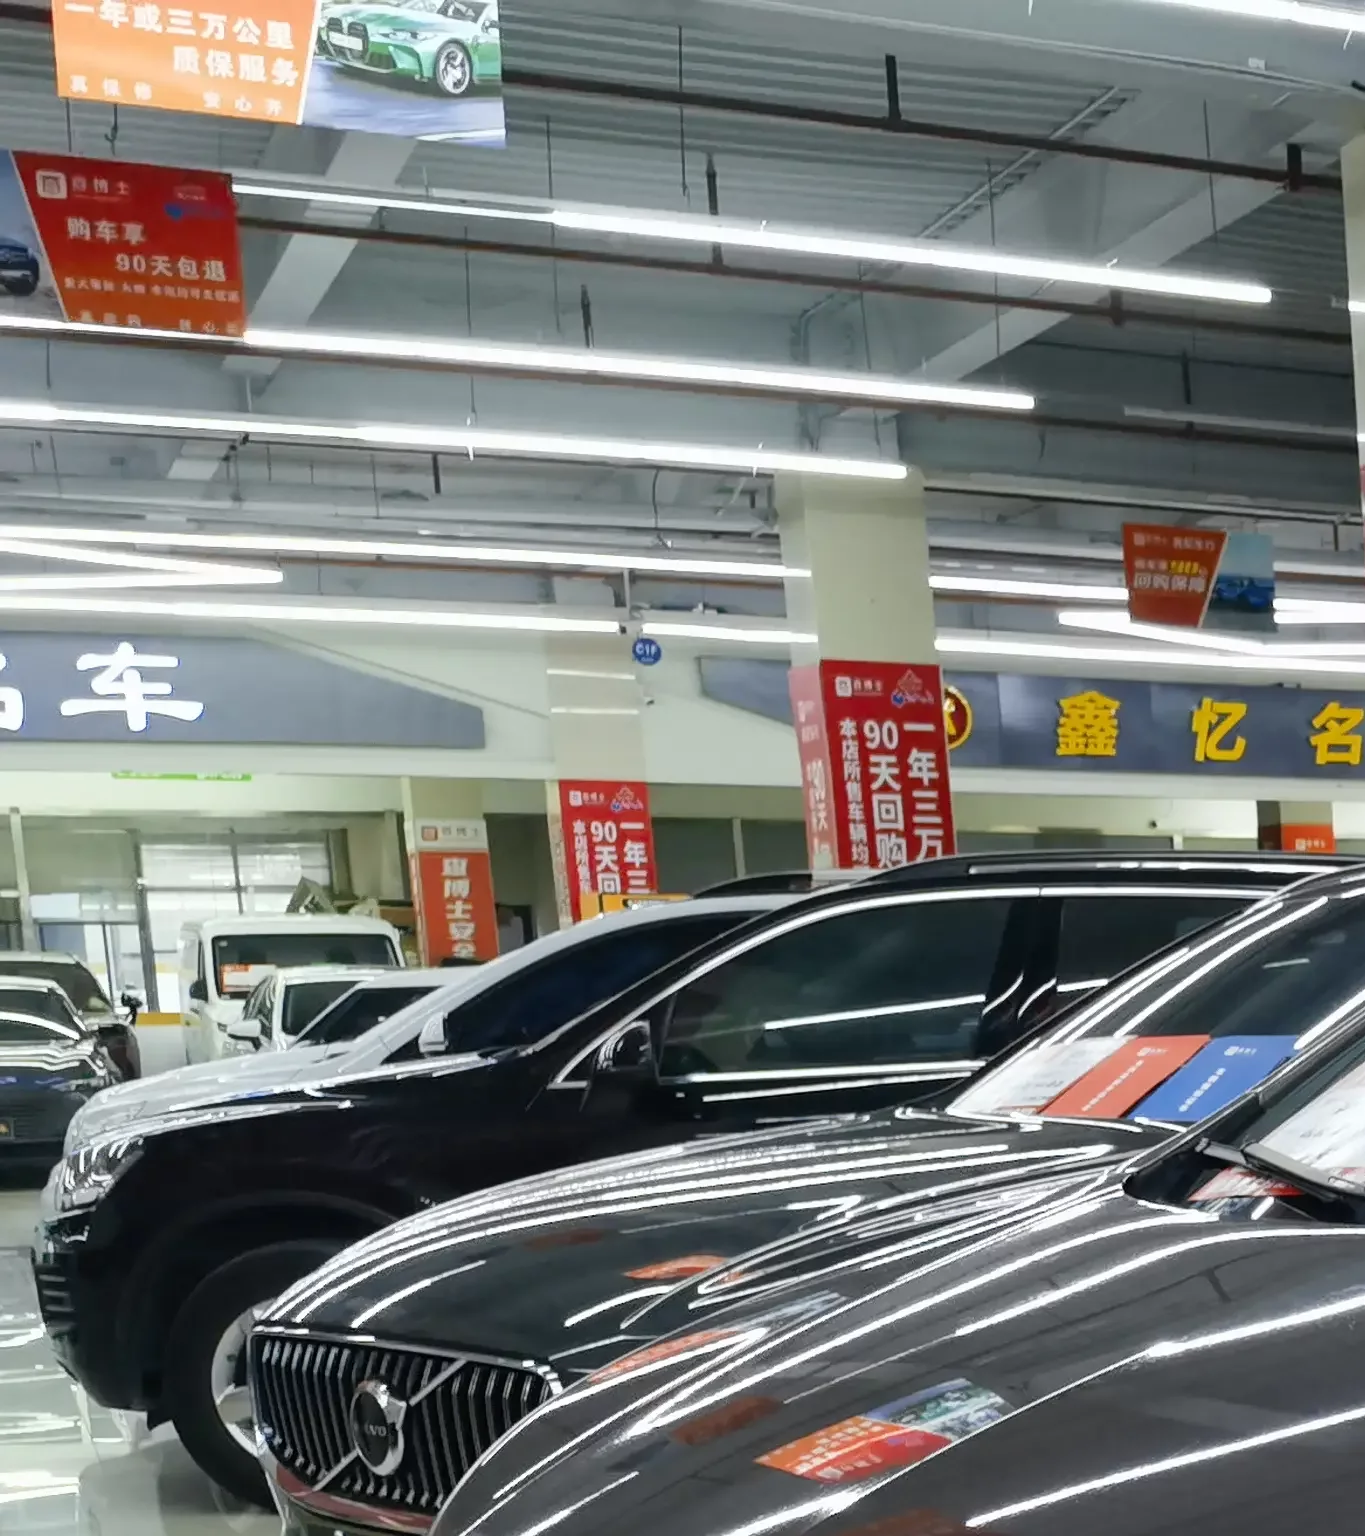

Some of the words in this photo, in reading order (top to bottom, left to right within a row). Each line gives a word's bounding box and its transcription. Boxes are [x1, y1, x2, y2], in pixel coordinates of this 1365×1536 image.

[173, 45, 299, 87] 质保服务
[115, 252, 226, 282] 90天包退
[0, 642, 204, 732] 车
[839, 717, 870, 869] 本店所售车辆均
[863, 719, 908, 869] 90天回购
[903, 723, 945, 862] 一年三万
[590, 820, 621, 893] 90天回
[620, 822, 651, 893] 一年三
